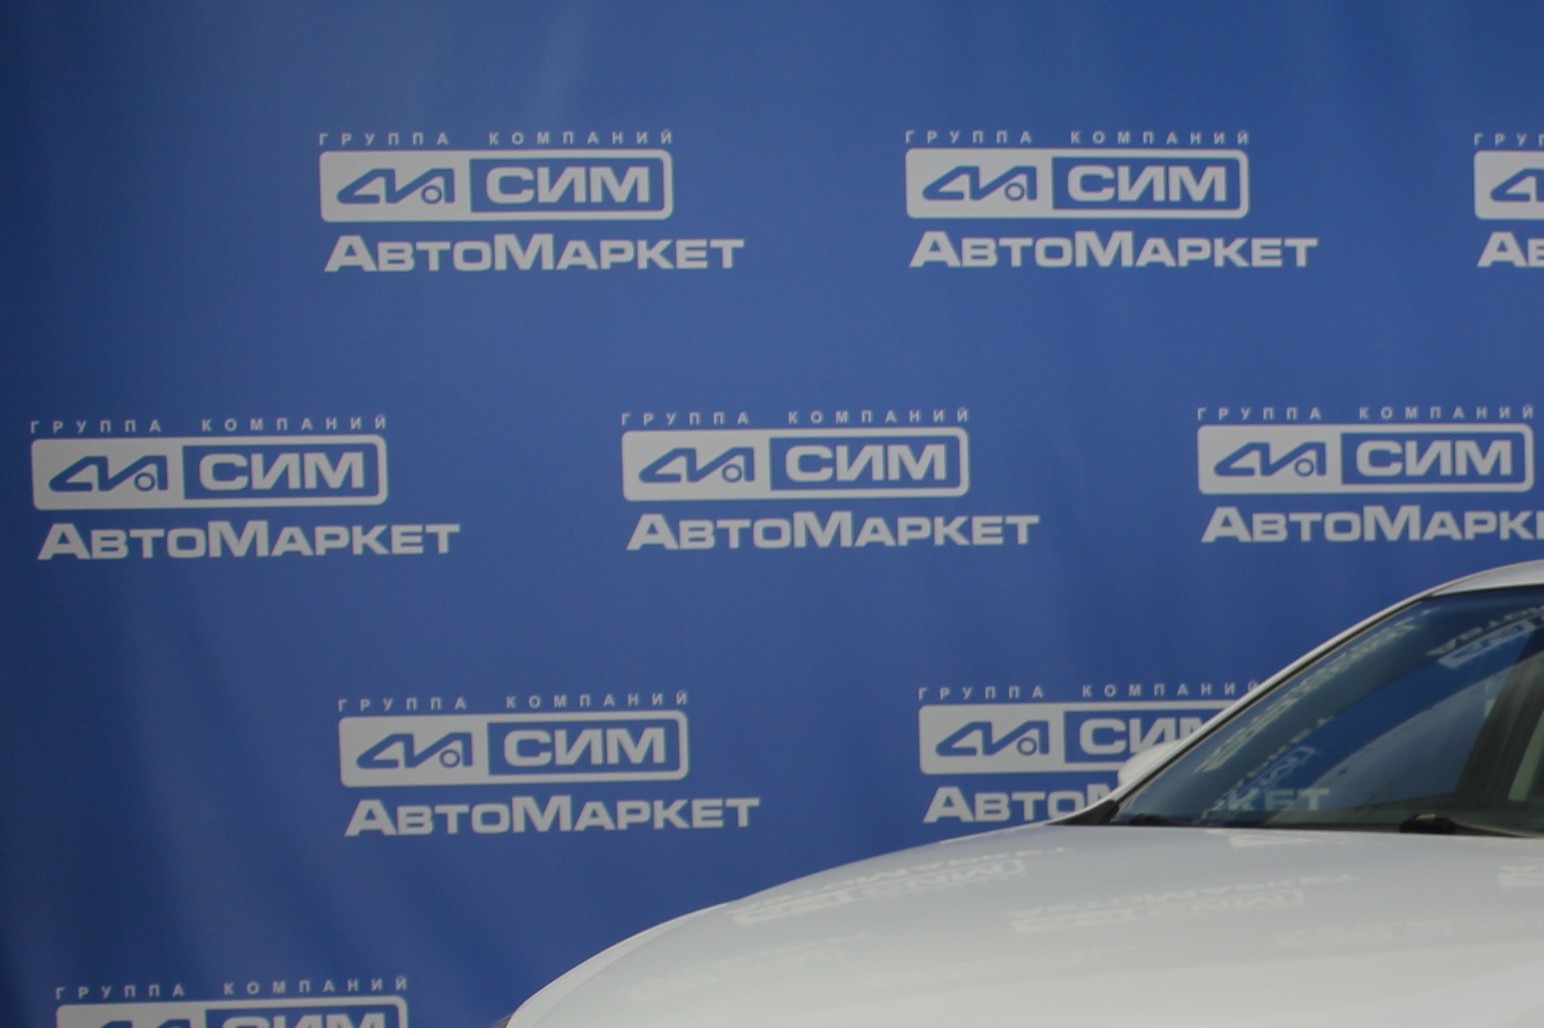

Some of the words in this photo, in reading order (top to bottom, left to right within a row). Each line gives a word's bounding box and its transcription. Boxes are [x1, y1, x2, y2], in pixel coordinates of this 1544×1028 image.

[319, 132, 448, 145] ГРУППА
[489, 130, 671, 144] КОМПАНИЙ
[905, 130, 1031, 143] ГРУППА
[1070, 130, 1248, 144] КОМПАНИЙ
[486, 167, 649, 203] СИМ
[1068, 165, 1226, 201] СИМ
[621, 412, 748, 425] ГРУППА
[788, 408, 968, 423] КОМПАНИЙ
[1197, 407, 1321, 420] ГРУППА
[1359, 405, 1533, 419] КОМПАНИЙ
[31, 419, 161, 433] ГРУППА
[202, 414, 386, 431] КОМПАНИЙ
[786, 444, 945, 481] СИМ
[1357, 440, 1511, 476] СИМ
[200, 452, 364, 490] СИМ
[338, 697, 466, 711] ГРУППА
[506, 691, 687, 708] КОМПАНИЙ
[918, 685, 1043, 700] ГРУППА
[504, 728, 665, 766] СИМ
[55, 984, 184, 999] ГРУППА
[224, 976, 406, 992] КОМПАНИЙ
